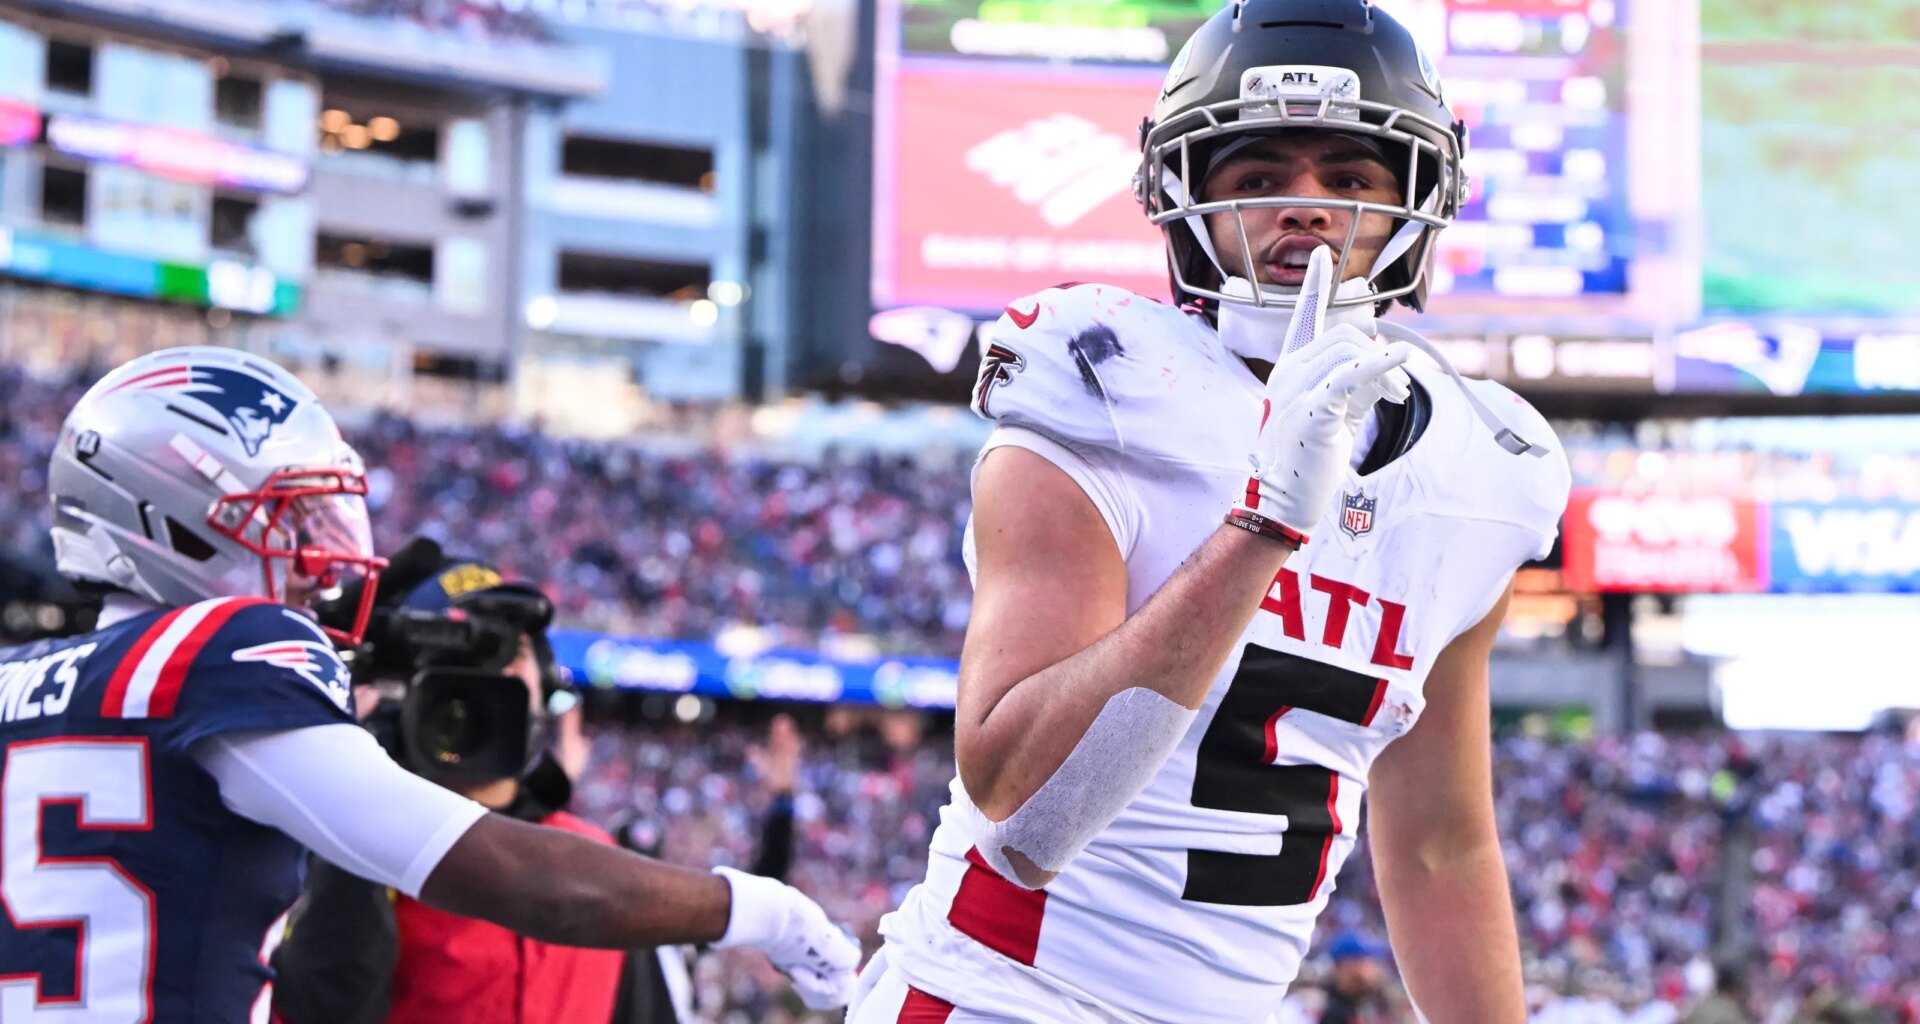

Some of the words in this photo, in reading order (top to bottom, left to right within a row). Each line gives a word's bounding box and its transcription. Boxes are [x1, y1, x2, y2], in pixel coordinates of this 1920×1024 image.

[1281, 72, 1319, 84] ATL
[1236, 520, 1249, 529] LOVE
[1248, 524, 1261, 533] YOU
[1346, 509, 1369, 530] NFL
[1259, 567, 1415, 672] ATL
[0, 642, 98, 723] NES
[1181, 642, 1389, 907] 5
